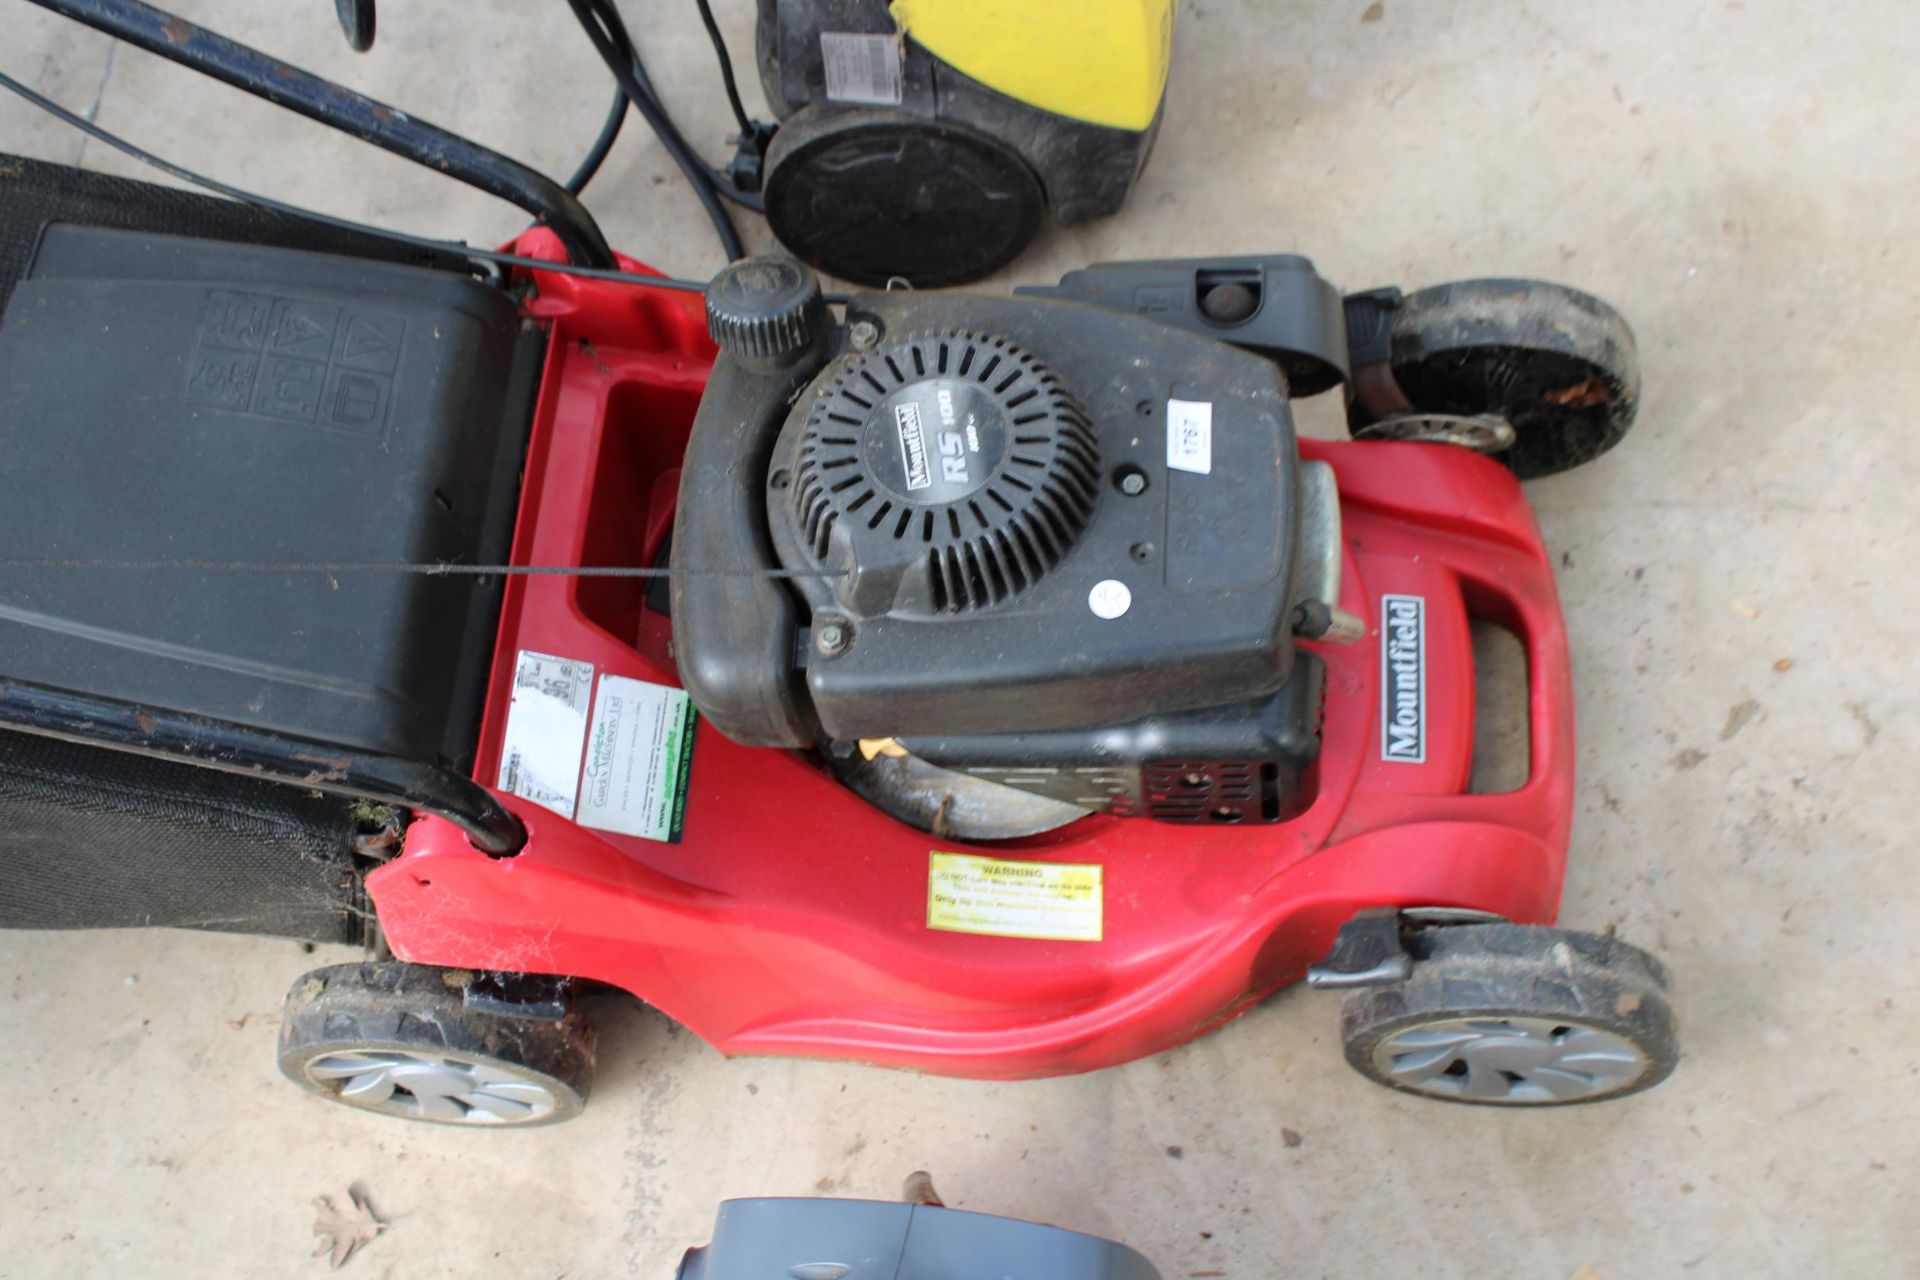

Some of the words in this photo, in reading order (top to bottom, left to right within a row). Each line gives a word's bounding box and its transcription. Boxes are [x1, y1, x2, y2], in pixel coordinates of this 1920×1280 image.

[939, 390, 955, 426] 100
[899, 405, 928, 487] Mountfield
[938, 432, 968, 483] RS
[1389, 601, 1418, 757] Mountfield
[984, 865, 1042, 878] WARNING
